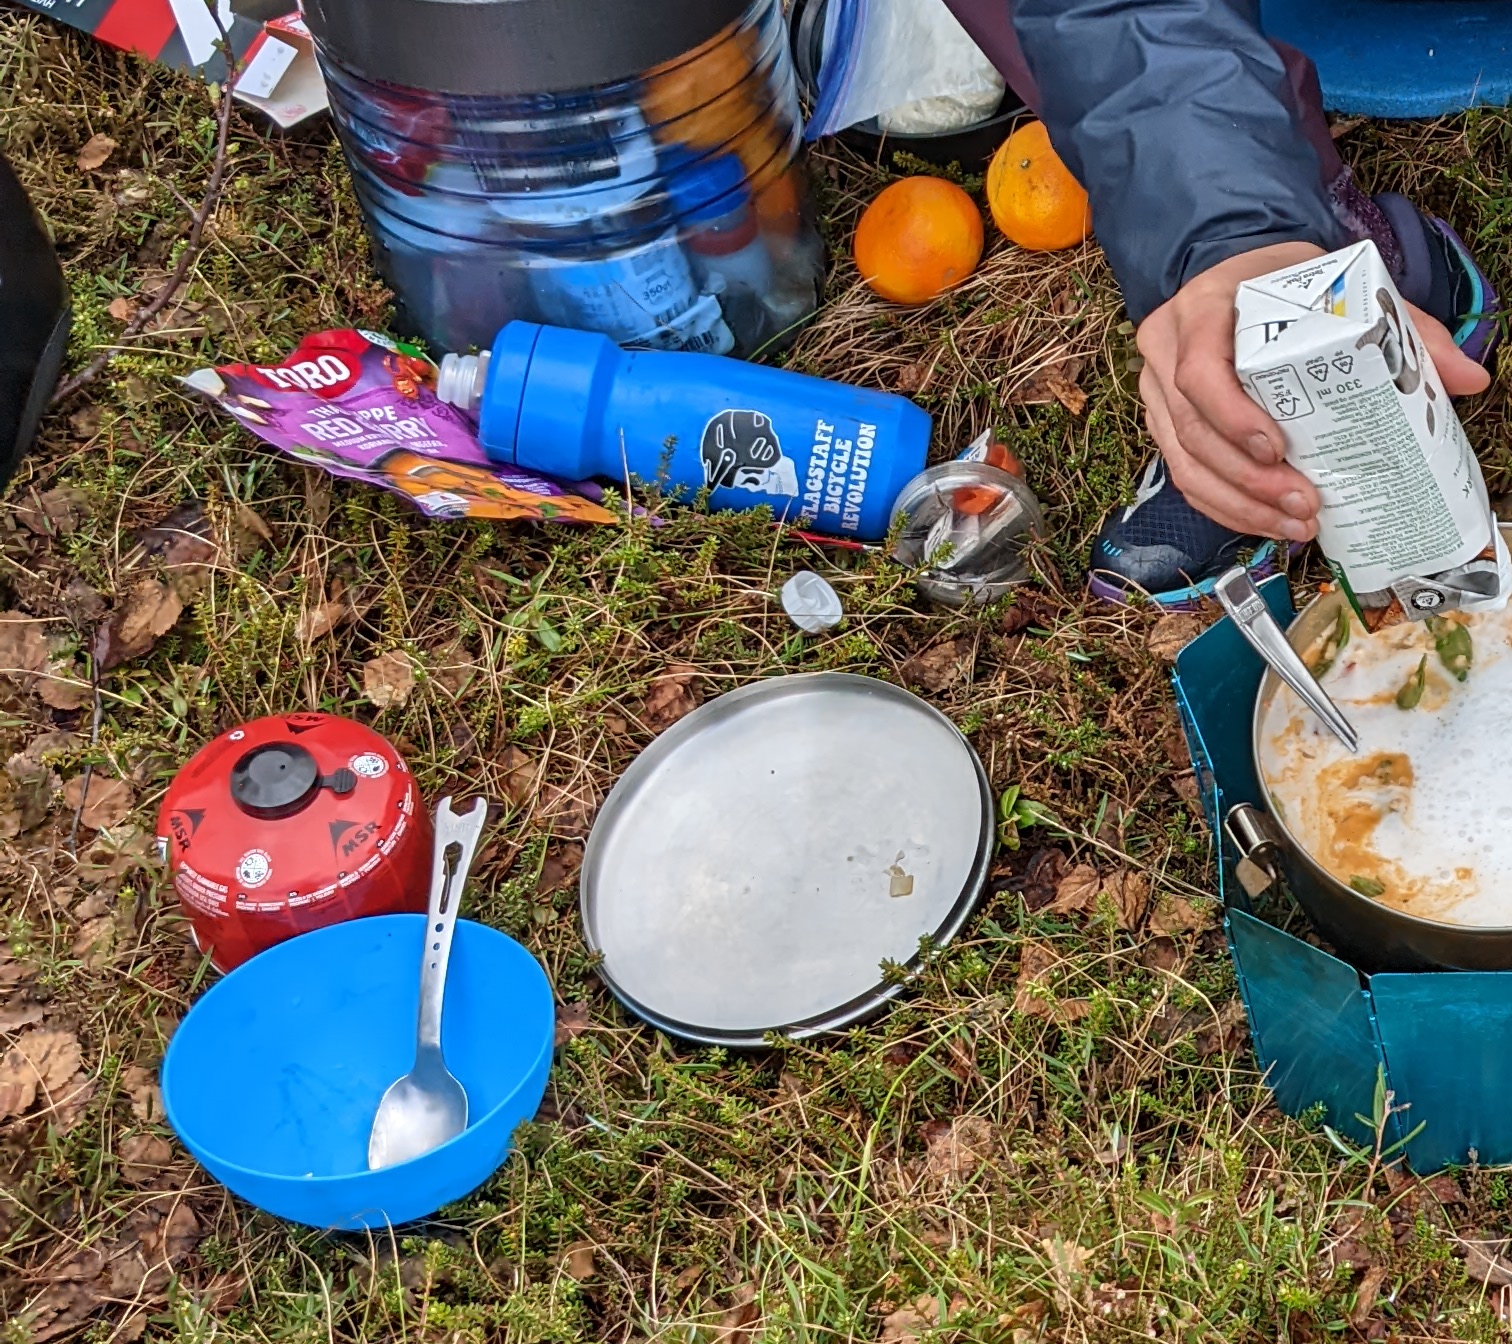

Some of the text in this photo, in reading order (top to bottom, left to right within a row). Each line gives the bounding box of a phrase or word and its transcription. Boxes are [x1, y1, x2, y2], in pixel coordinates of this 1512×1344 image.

[256, 355, 351, 391] TORO
[1316, 378, 1363, 400] 330 ml
[301, 416, 364, 441] RED
[801, 419, 834, 520] FLAGSTAFF
[823, 438, 853, 515] BICYCLE
[841, 423, 877, 531] REVOLUTION
[170, 815, 192, 853] MSR
[341, 820, 382, 857] MSR
